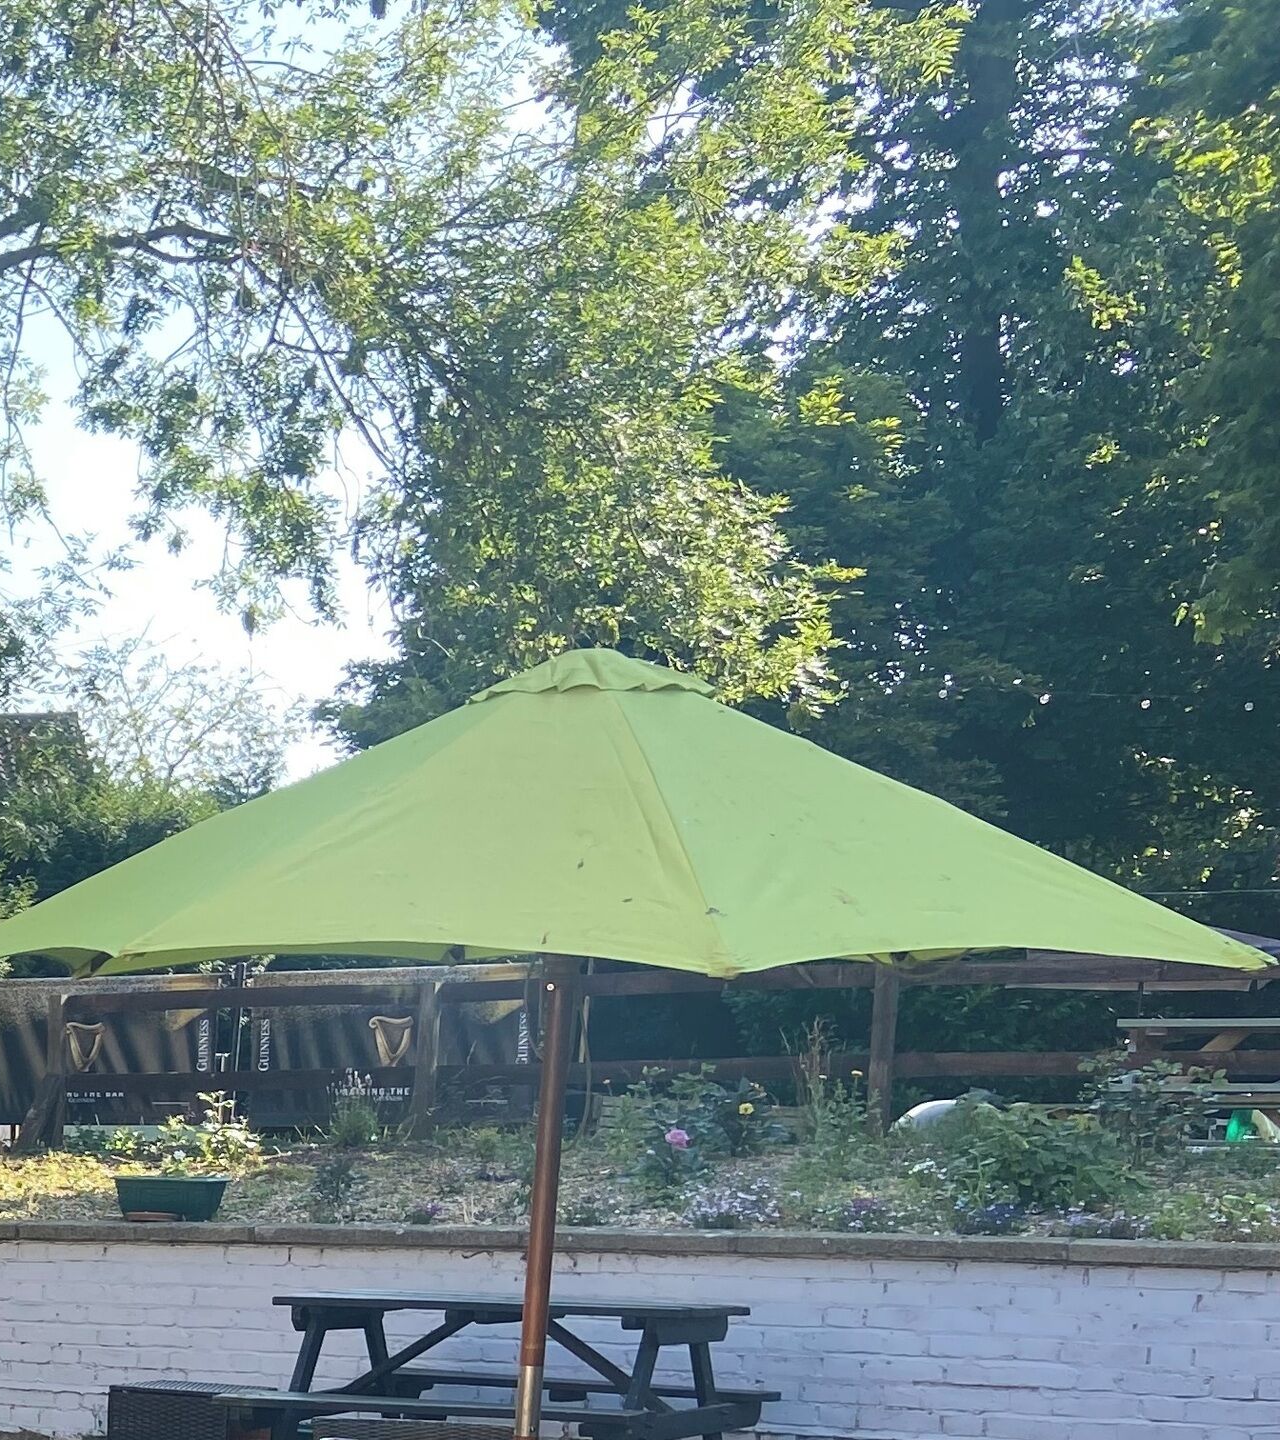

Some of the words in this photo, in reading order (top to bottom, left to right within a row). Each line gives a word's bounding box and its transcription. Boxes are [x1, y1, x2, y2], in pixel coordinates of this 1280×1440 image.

[197, 1019, 209, 1072] GUINNESS
[258, 1018, 270, 1072] GUINNESS
[390, 1087, 411, 1096] THE
